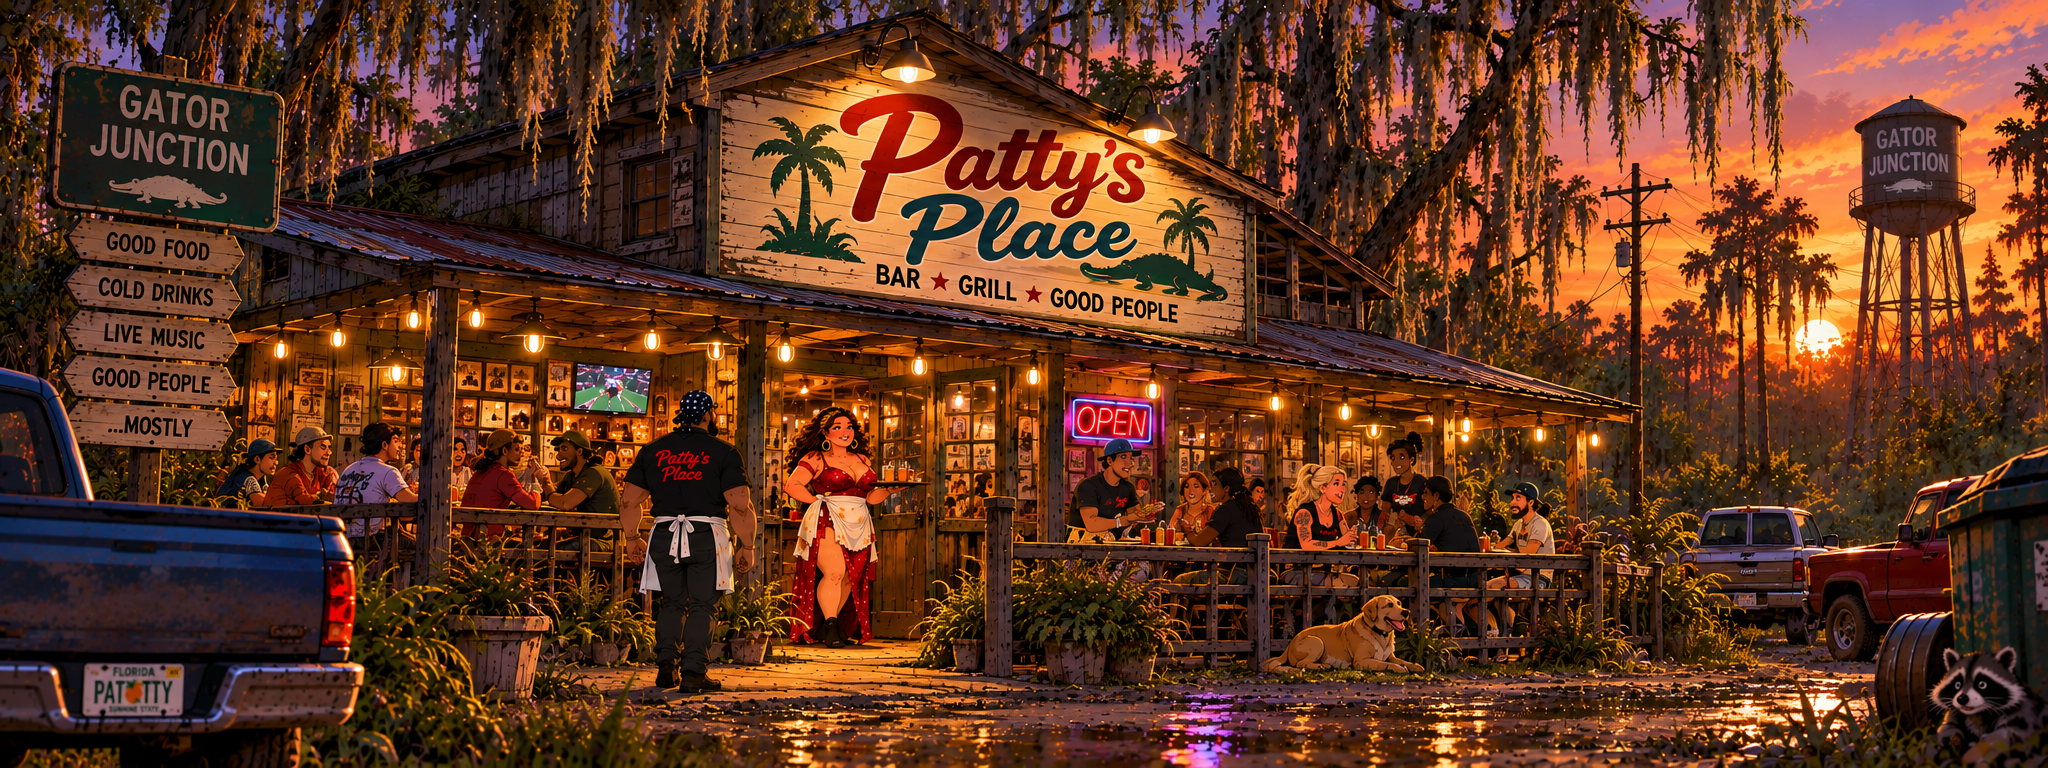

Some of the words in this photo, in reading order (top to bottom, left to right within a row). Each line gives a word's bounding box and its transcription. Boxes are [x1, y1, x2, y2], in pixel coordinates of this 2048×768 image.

[119, 84, 230, 133] GATOR
[89, 123, 250, 176] JUNCTION
[1876, 126, 1937, 149] GATOR
[839, 92, 1146, 223] Patty's
[1869, 151, 1949, 176] JUNCTION
[900, 193, 1138, 266] Place
[106, 231, 156, 255] GOOD
[163, 238, 210, 261] FOOD
[98, 276, 145, 300] COLD
[151, 283, 214, 307] DRINKS
[876, 263, 921, 289] BAR
[958, 274, 1017, 302] GRILL
[1050, 287, 1104, 313] GOOD
[1111, 295, 1179, 324] PEOPLE
[103, 322, 143, 344] LIVE
[150, 327, 206, 350] MUSIC
[92, 367, 141, 389] GOOD
[147, 371, 212, 394] PEOPLE
[1077, 406, 1147, 437] OPEN
[655, 449, 711, 470] Patty's
[661, 465, 703, 483] Place
[112, 666, 156, 677] FLORIDA
